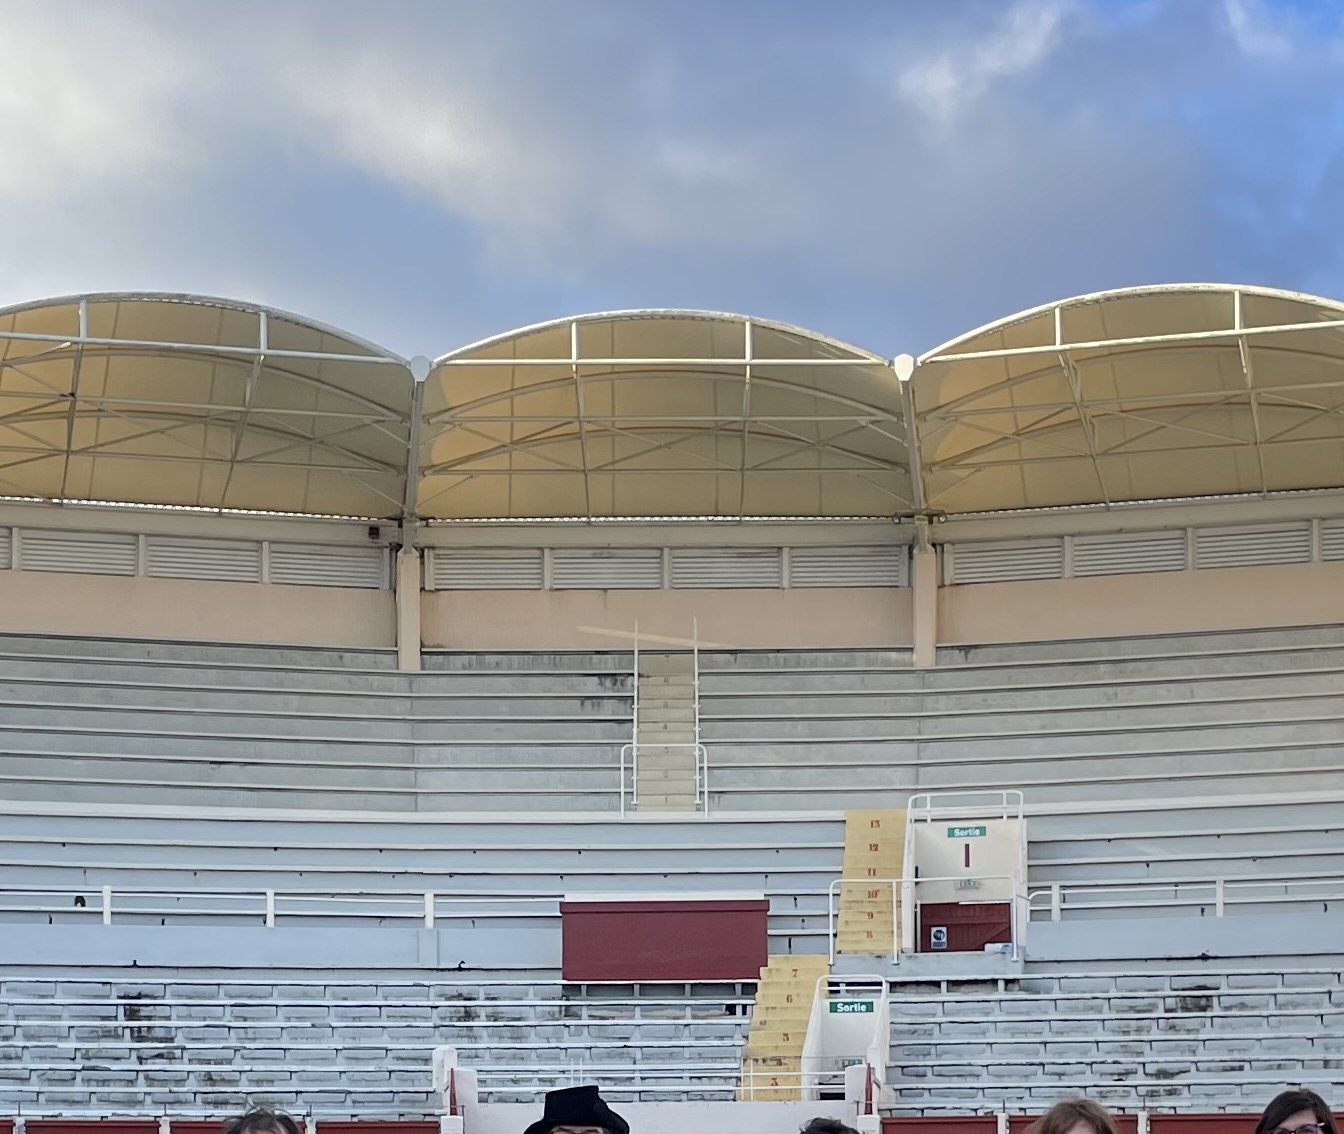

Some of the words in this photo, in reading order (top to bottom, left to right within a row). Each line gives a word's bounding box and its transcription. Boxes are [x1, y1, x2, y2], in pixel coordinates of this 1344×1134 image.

[954, 828, 980, 837] Sortie
[869, 843, 879, 851] 12
[965, 843, 970, 868] I
[837, 1002, 867, 1012] Sortie
